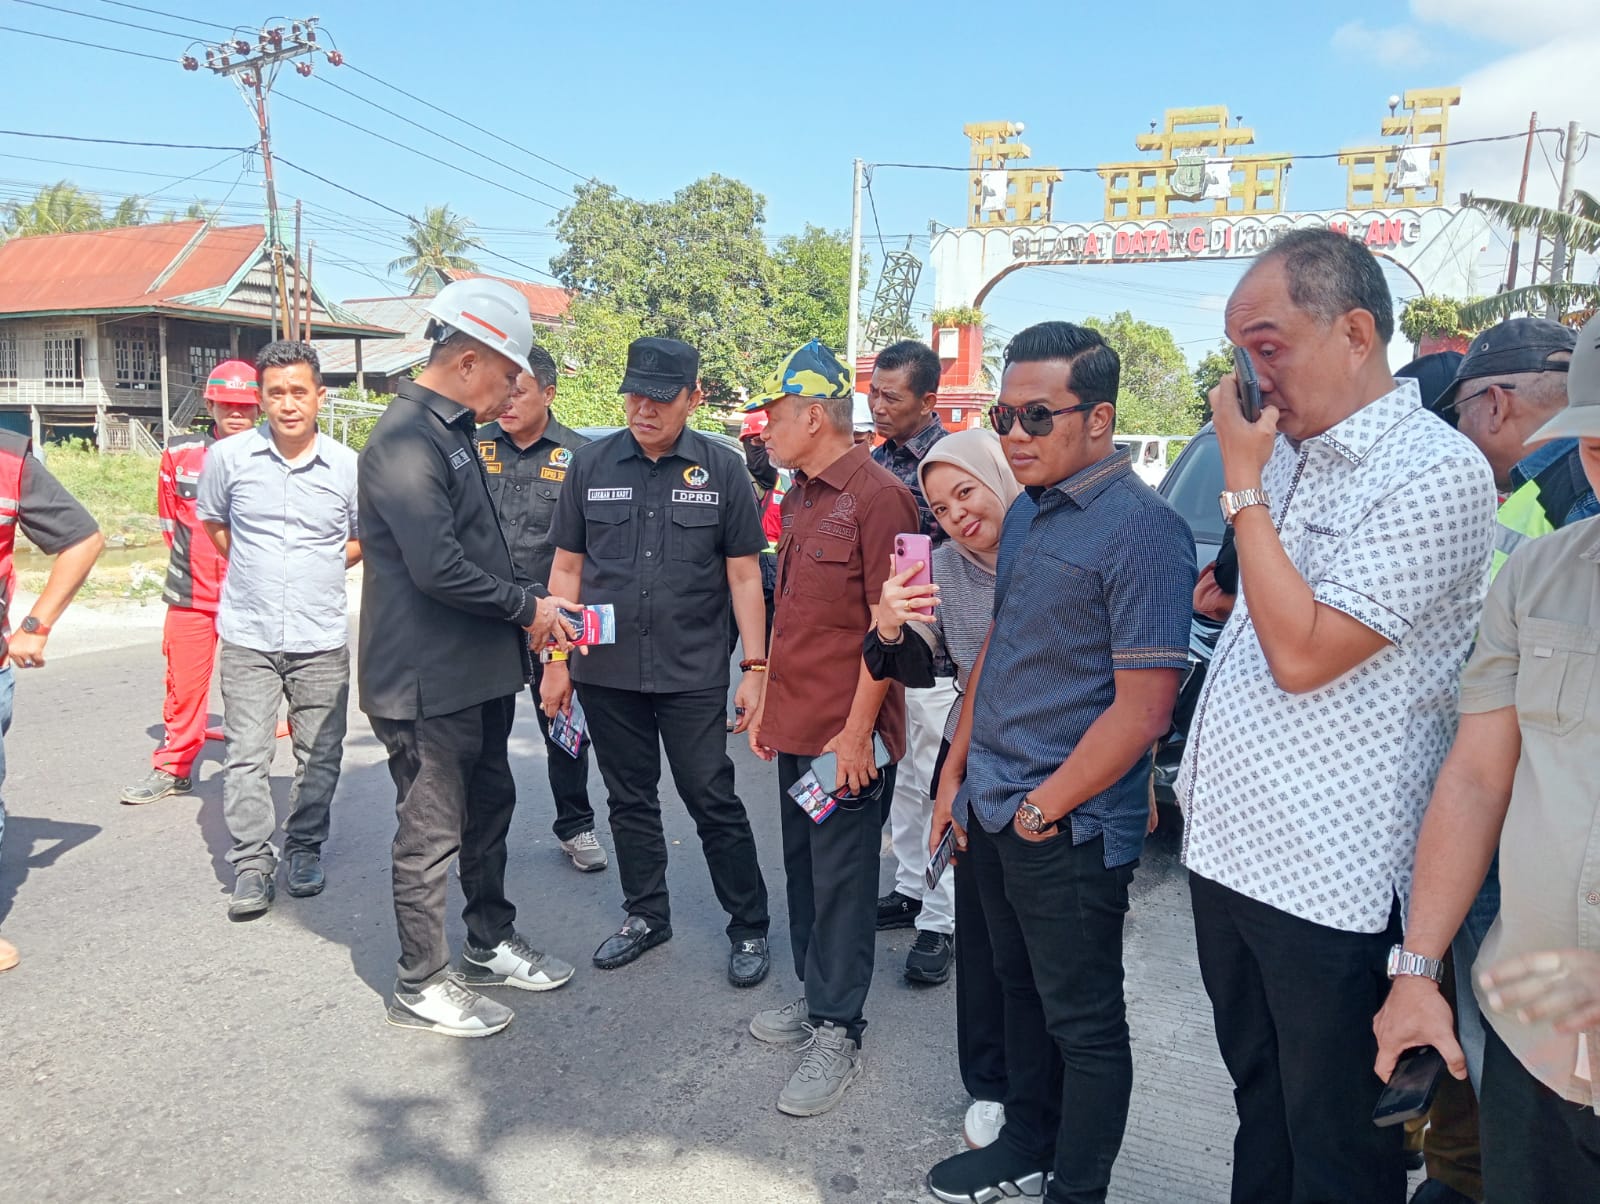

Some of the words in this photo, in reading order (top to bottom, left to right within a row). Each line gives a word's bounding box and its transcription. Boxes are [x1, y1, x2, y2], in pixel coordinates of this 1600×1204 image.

[1012, 231, 1112, 259] SLAMAT
[1115, 227, 1205, 255] DATANG
[680, 492, 712, 502] DPRD
